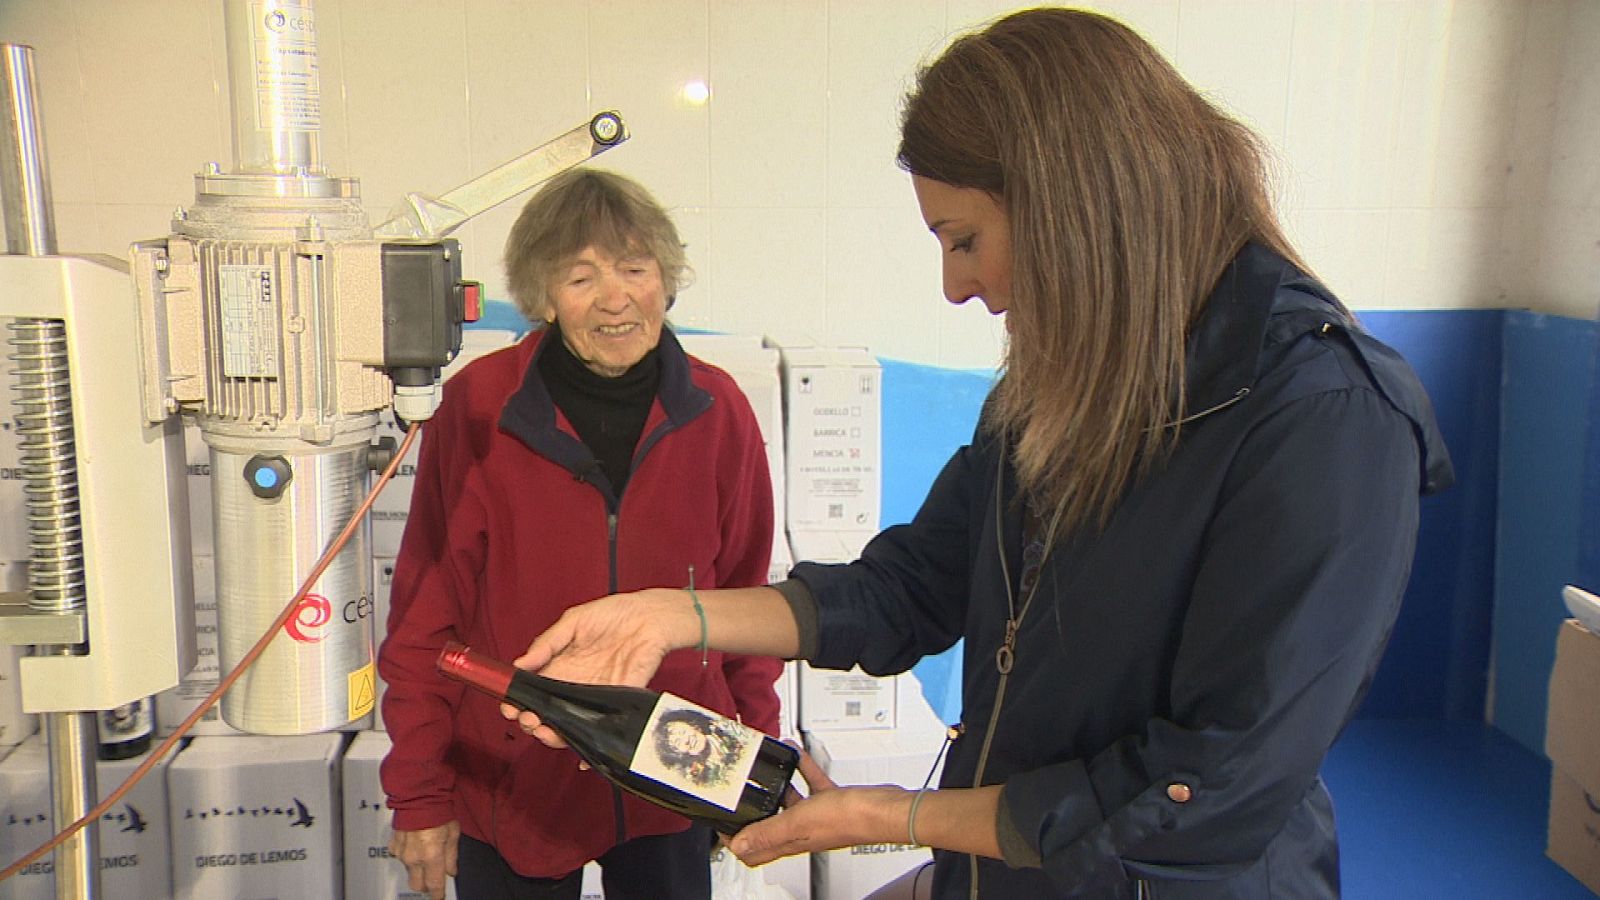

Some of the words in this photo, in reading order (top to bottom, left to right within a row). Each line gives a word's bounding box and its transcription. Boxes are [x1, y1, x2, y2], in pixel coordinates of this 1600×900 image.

[813, 407, 849, 416] GODELLO
[814, 428, 848, 438] BARRICA
[195, 854, 237, 868] DIEGO
[239, 852, 258, 866] DE
[260, 848, 307, 864] LEMOS
